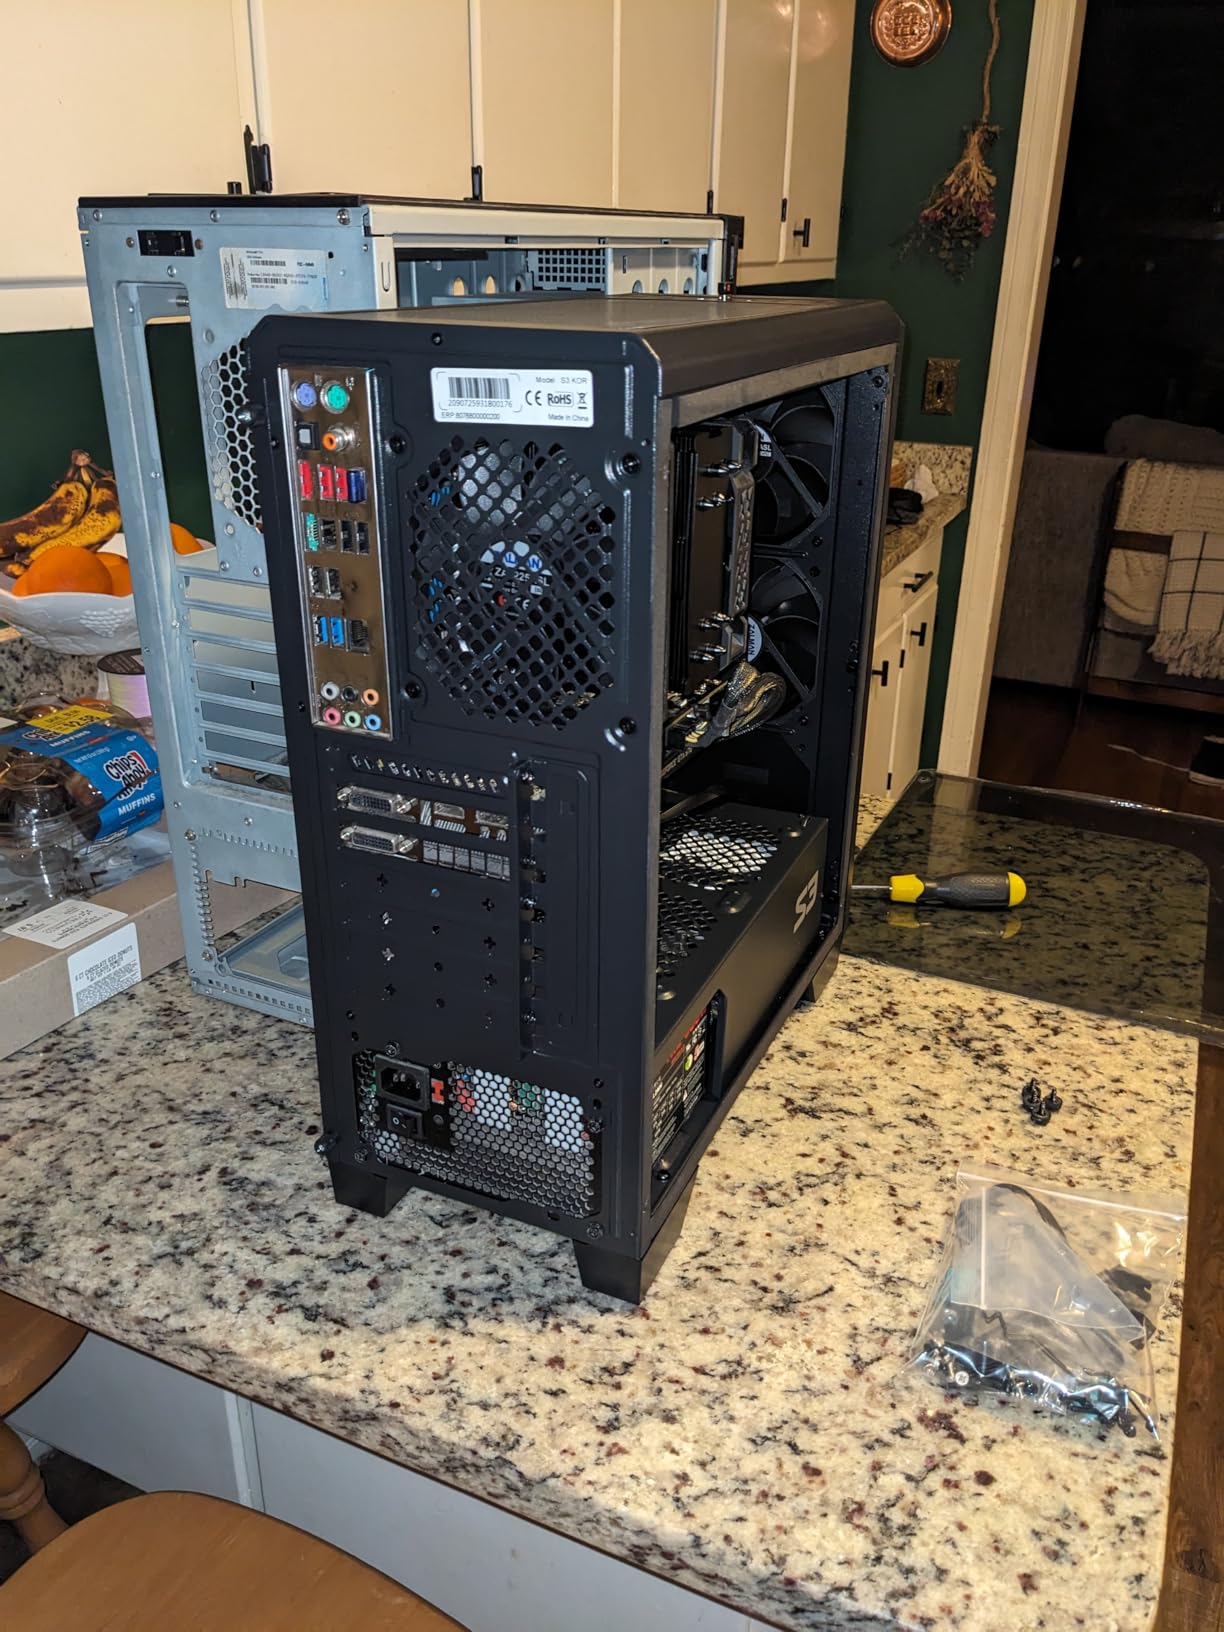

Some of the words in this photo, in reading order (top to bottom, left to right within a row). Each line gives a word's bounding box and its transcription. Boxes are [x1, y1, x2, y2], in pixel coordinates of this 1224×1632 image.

[548, 393, 572, 406] RoHS
[548, 413, 564, 421] Made
[572, 414, 590, 423] China
[104, 753, 138, 780] Chips
[117, 793, 156, 816] MUFFINS
[793, 869, 819, 934] S3
